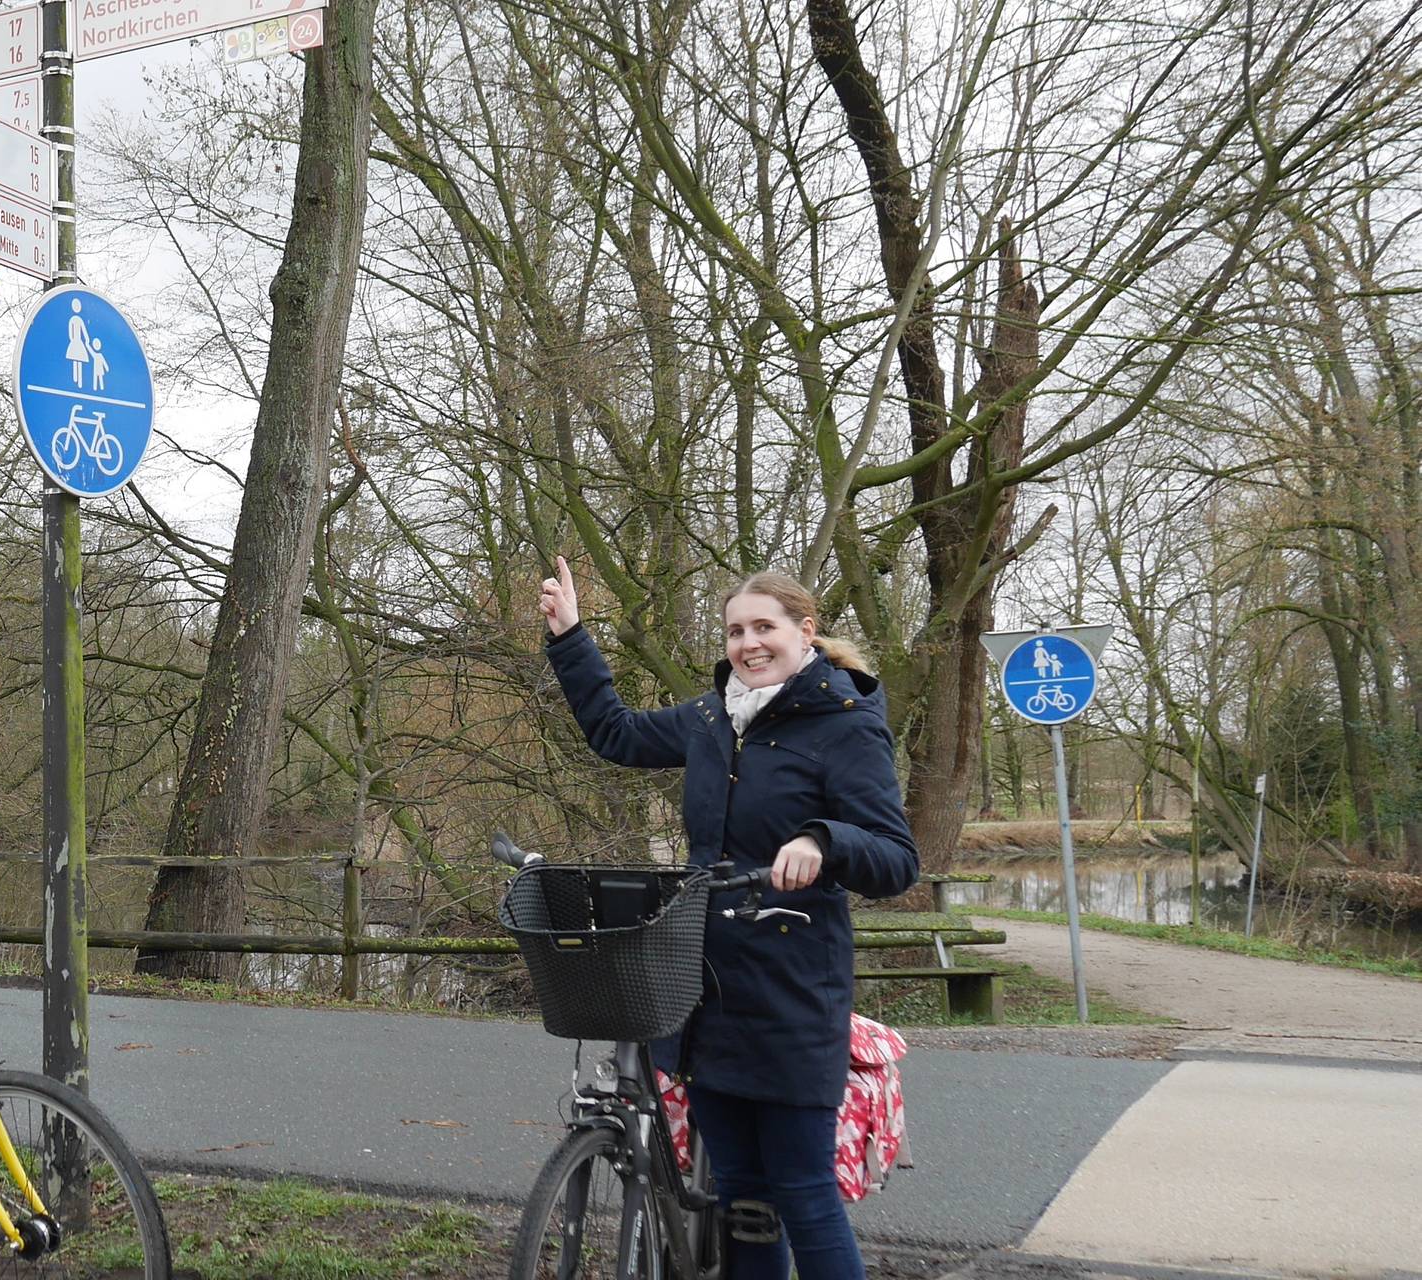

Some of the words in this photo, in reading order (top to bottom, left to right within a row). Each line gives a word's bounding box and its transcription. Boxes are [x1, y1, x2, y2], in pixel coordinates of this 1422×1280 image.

[9, 18, 23, 38] 17
[82, 9, 198, 48] Nordkirchen
[297, 23, 313, 38] 24
[9, 45, 23, 65] 16
[13, 90, 30, 109] 7,5
[30, 144, 39, 166] 15
[30, 173, 39, 193] 13
[33, 246, 46, 267] 0,5
